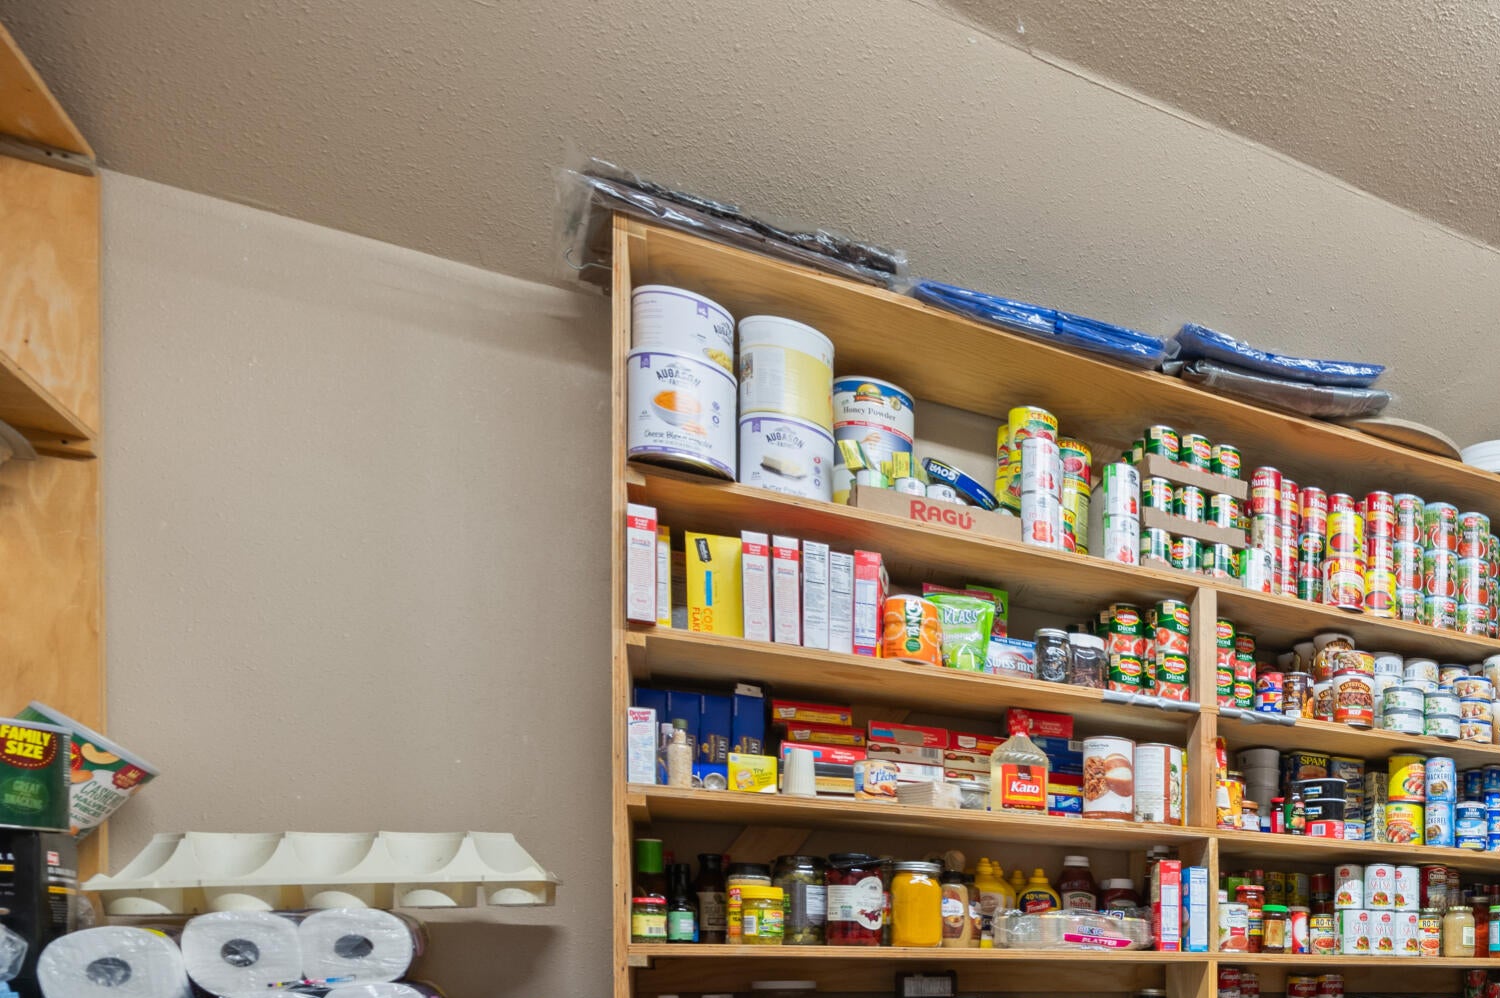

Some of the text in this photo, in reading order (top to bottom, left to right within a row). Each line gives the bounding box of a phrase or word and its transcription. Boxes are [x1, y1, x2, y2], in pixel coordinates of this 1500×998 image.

[843, 406, 896, 421] Honey Powder
[1030, 412, 1057, 428] CENTO
[1059, 441, 1089, 454] CENTO
[910, 500, 974, 530] RAGÚ
[692, 607, 700, 632] FLAKE
[906, 600, 922, 638] TANG
[944, 608, 978, 624] KLASS
[1122, 674, 1139, 683] Diced
[1166, 673, 1184, 681] Diced
[1340, 682, 1371, 692] KEYSTONE
[0, 724, 52, 746] FAMILY
[5, 740, 44, 760] SIZE
[1301, 756, 1326, 767] SPAM
[1010, 780, 1039, 794] Karo
[1082, 937, 1117, 946] PLATTER
